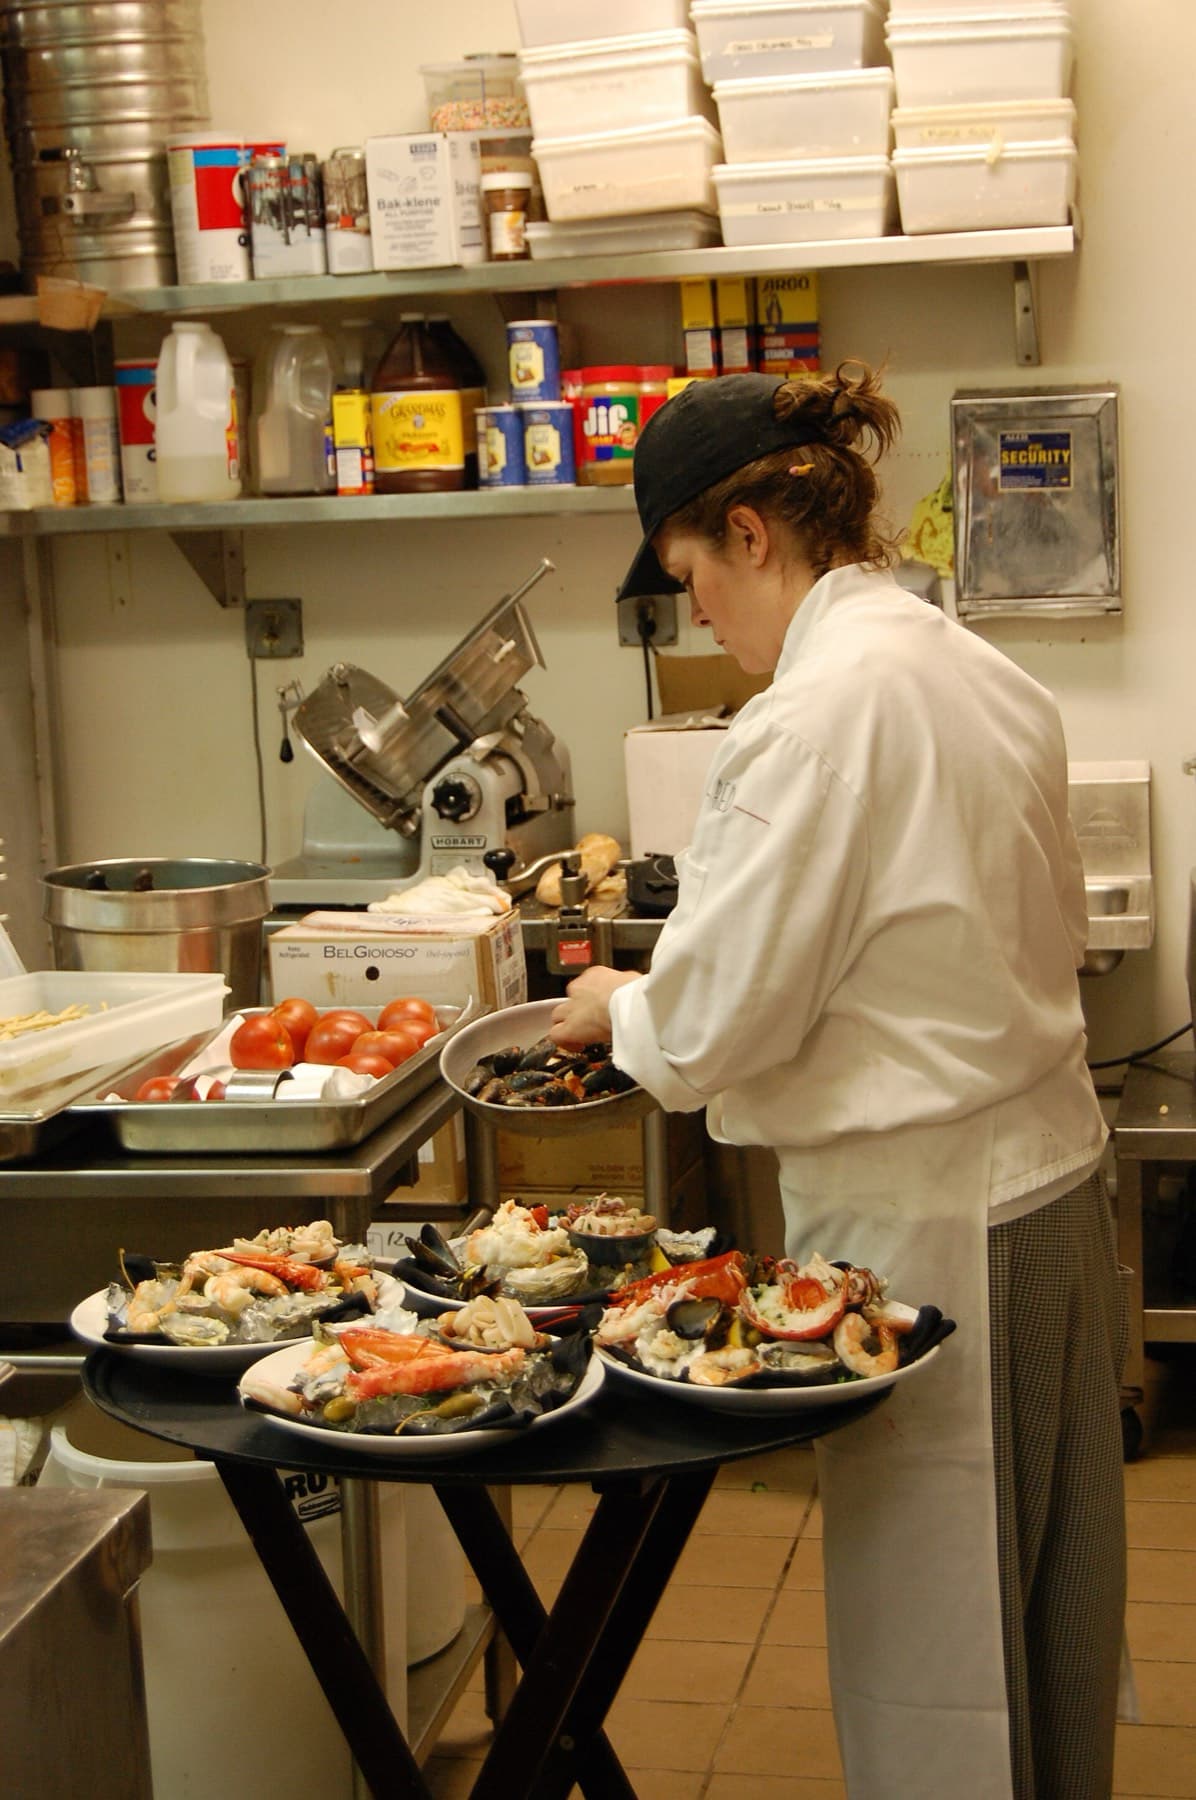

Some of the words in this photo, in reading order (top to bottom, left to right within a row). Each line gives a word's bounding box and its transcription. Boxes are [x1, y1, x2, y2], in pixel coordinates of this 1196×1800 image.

[377, 196, 441, 210] Bak-klene
[583, 404, 628, 436] Jif
[1001, 449, 1070, 464] SECURITY
